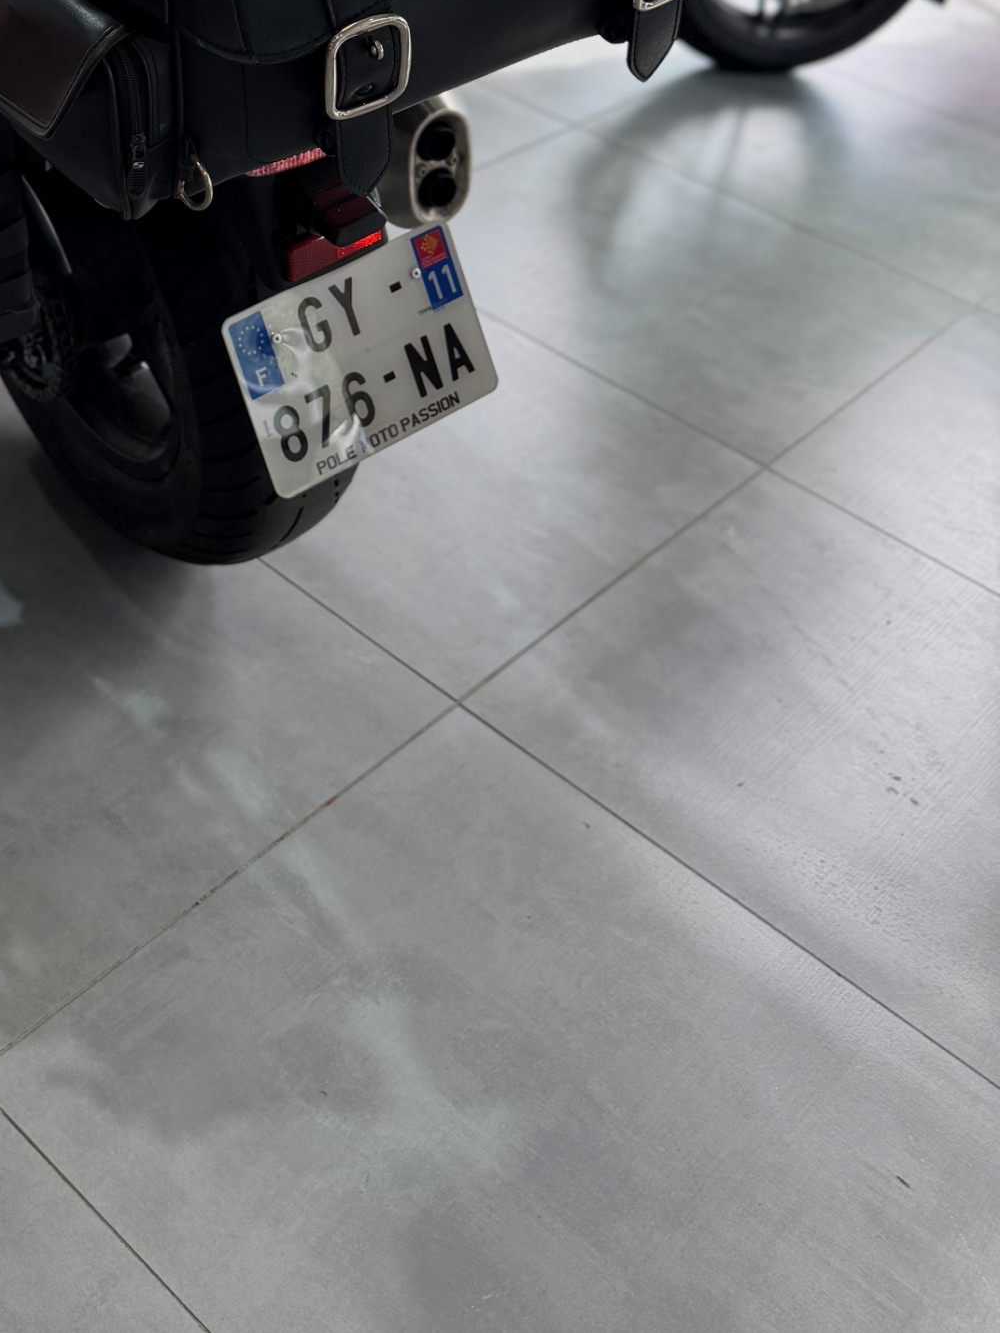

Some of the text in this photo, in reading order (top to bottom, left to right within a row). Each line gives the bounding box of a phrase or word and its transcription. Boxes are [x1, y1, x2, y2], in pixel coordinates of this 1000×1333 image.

[427, 263, 458, 301] 11
[297, 276, 361, 353] GY
[255, 366, 269, 388] F
[316, 444, 358, 475] POLE
[400, 391, 461, 433] PASSION
